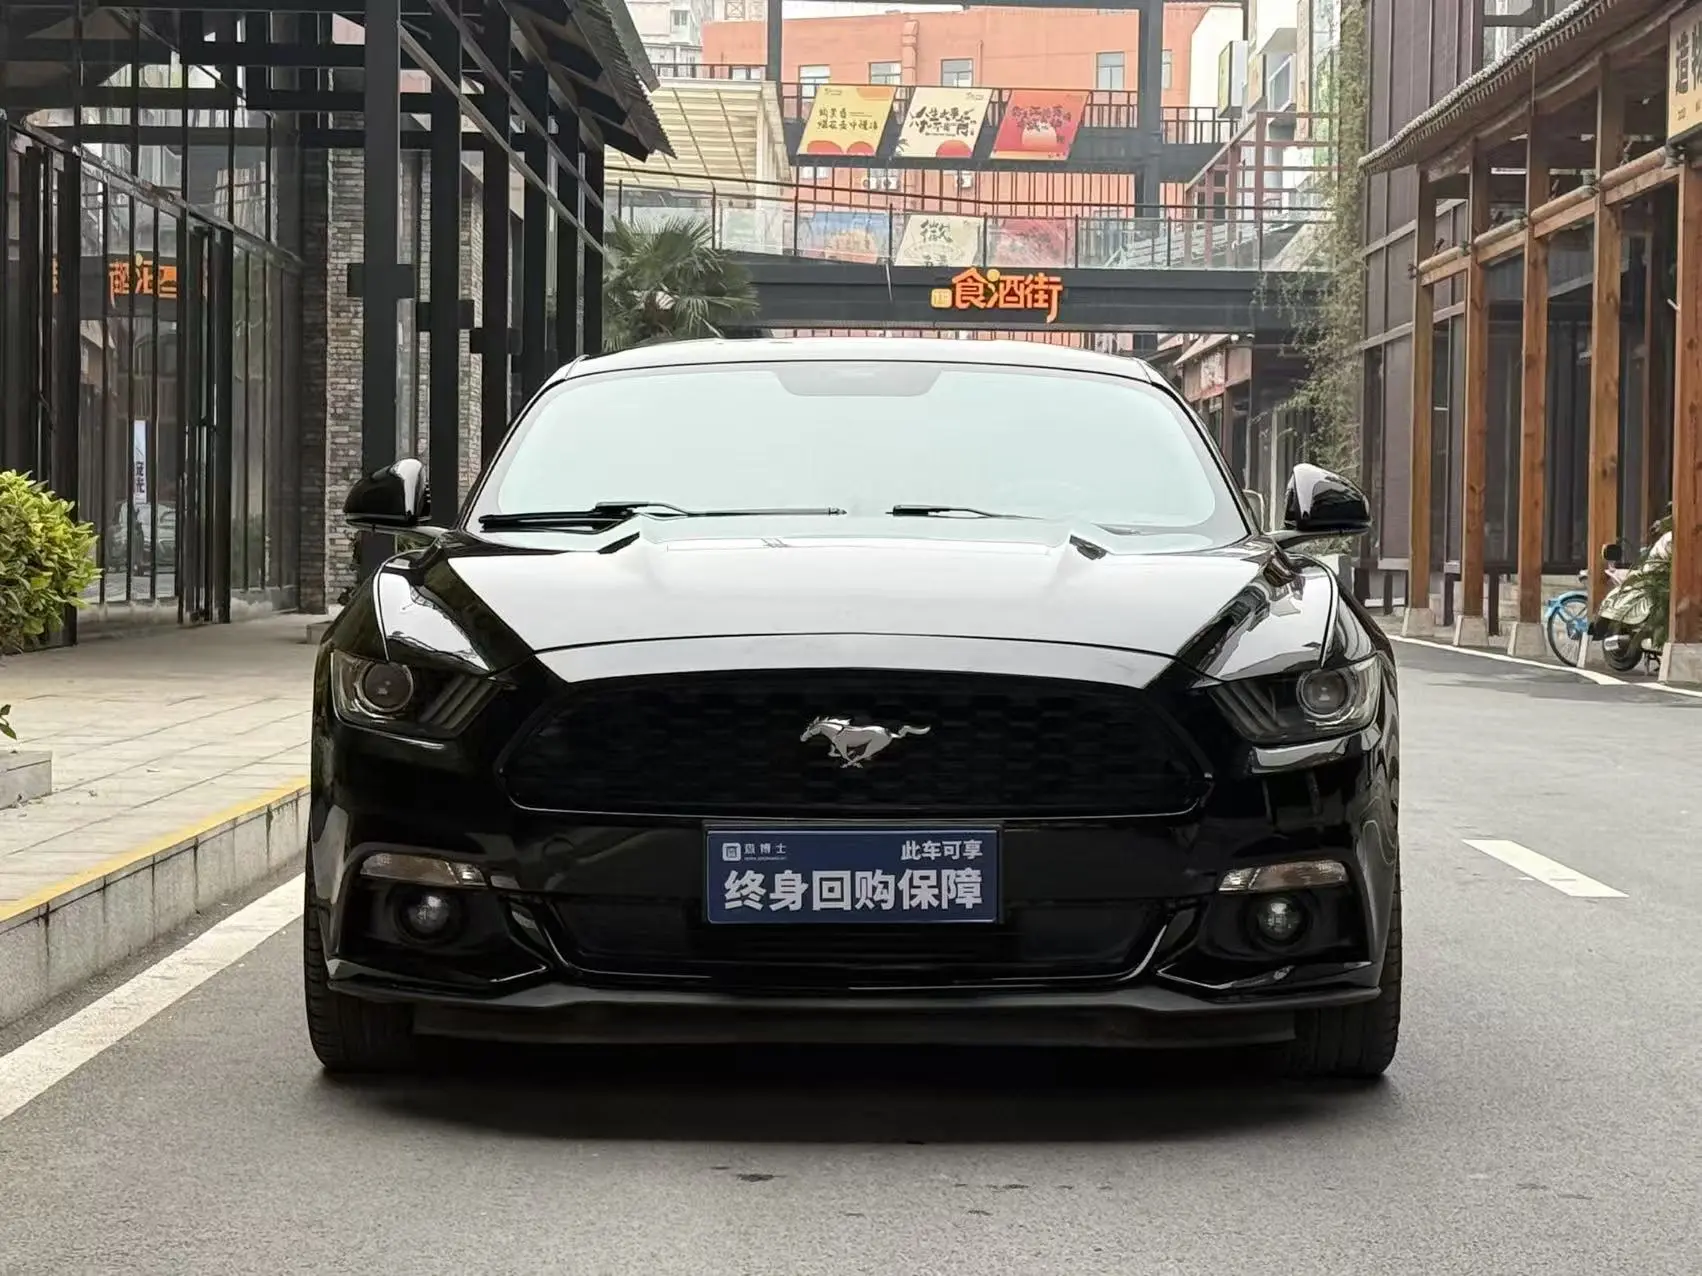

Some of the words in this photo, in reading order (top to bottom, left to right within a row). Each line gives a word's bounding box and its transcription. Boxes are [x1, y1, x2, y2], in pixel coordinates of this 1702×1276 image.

[952, 267, 1063, 323] 食酒街
[901, 839, 983, 860] 此车可享
[724, 867, 983, 911] 终身回购保障
